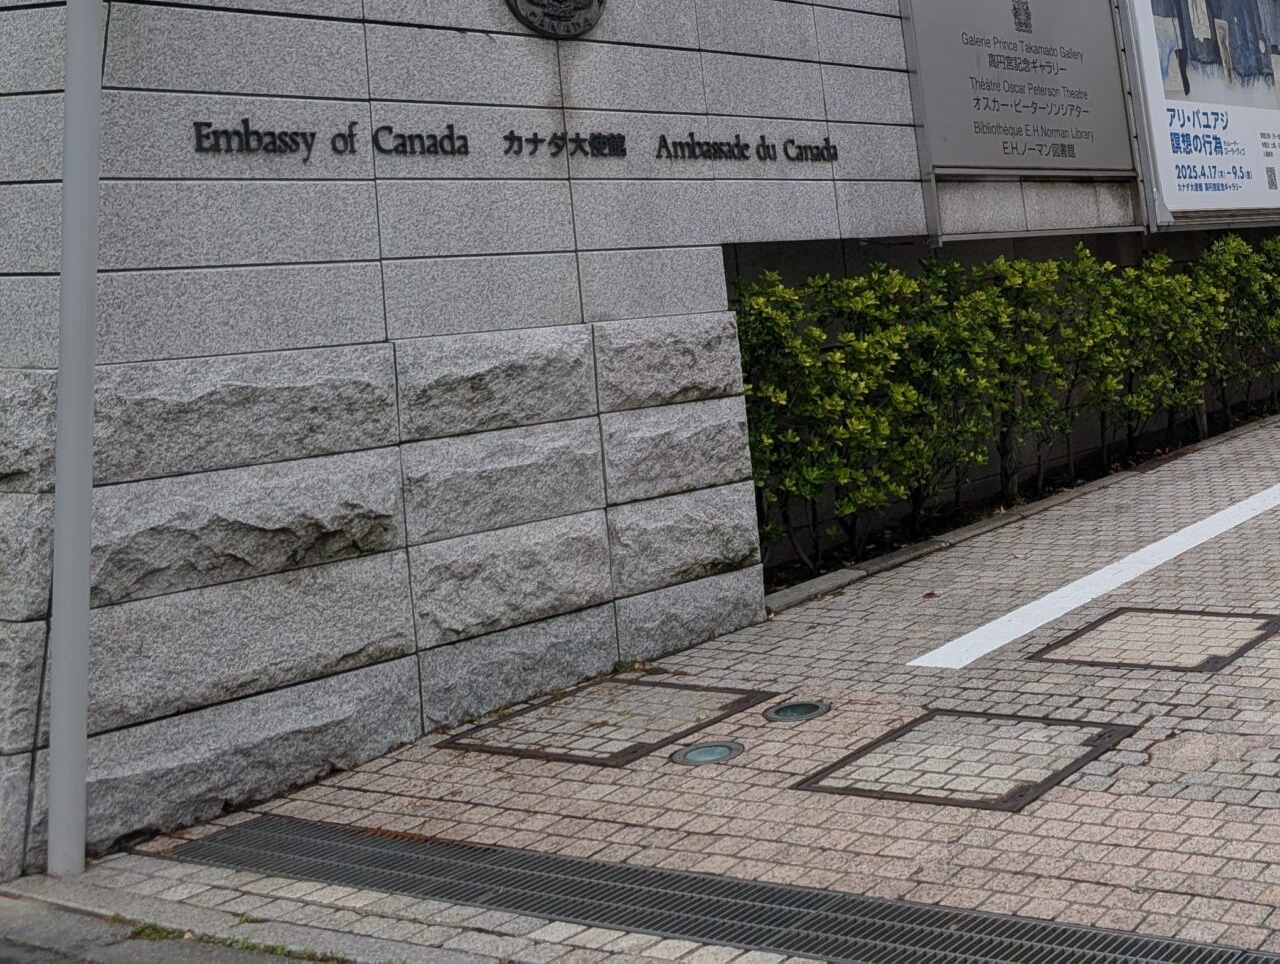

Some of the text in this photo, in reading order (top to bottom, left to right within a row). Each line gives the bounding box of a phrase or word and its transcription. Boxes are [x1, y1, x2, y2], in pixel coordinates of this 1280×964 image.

[961, 32, 1084, 64] Galerie Prince Takamado Gallery
[987, 53, 1067, 76] 高円宮記念ギャラリー
[1002, 79, 1026, 95] Oscar
[1027, 82, 1061, 97] Peterson
[1061, 86, 1089, 100] Theatre
[193, 118, 470, 164] Embassy of Canada
[503, 129, 627, 158] カナダ大使館
[973, 121, 1024, 139] Bibliothèque
[1071, 127, 1095, 143] Library
[655, 131, 839, 163] Ambassade du Canada
